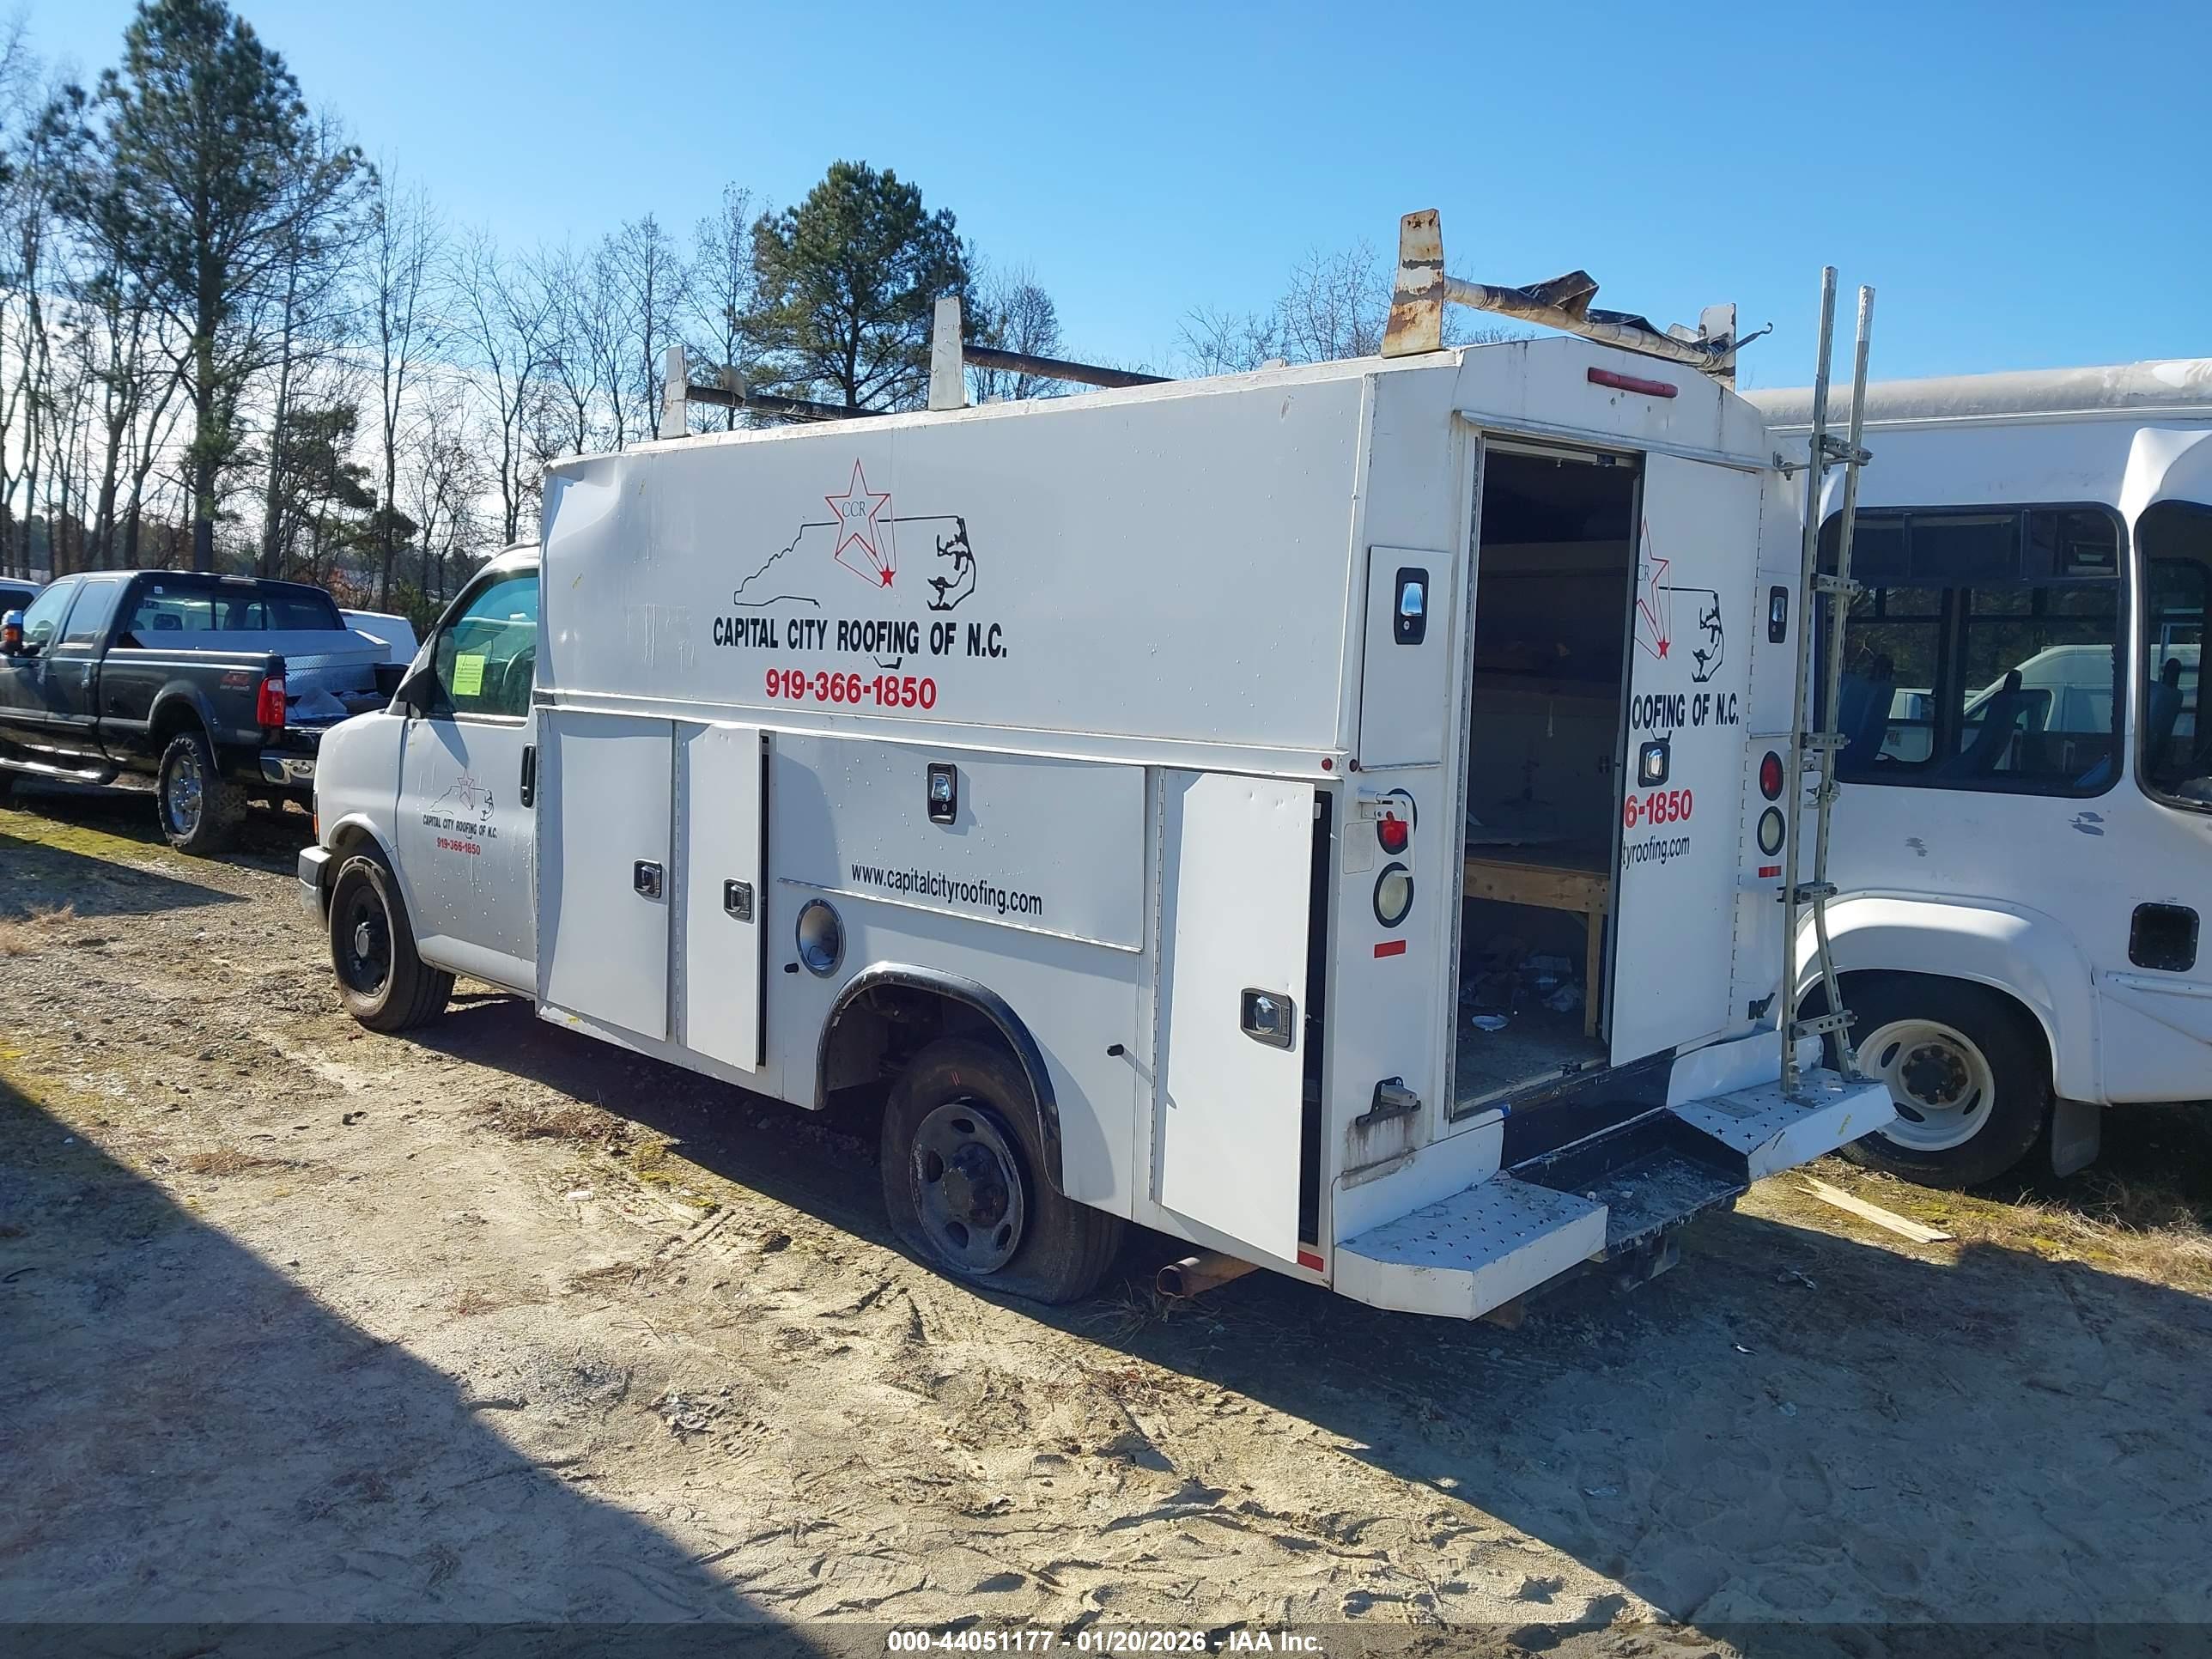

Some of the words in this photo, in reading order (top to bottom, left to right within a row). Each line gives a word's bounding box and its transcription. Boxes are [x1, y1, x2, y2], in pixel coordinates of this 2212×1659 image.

[842, 501, 866, 518] CCR
[712, 617, 779, 650] CAPITAL
[787, 619, 828, 652] CITY
[837, 620, 919, 654] ROOFING
[930, 623, 957, 656] OF
[967, 623, 1008, 659] N.C.
[765, 668, 937, 710] 919-366-1850
[1632, 693, 1686, 730] OOFING
[1692, 693, 1711, 726] OF
[1716, 692, 1740, 726] N.C.
[422, 814, 441, 828] CAPITAL
[442, 818, 454, 830] CITY
[455, 821, 477, 835] ROOFING
[478, 824, 487, 836] OF
[488, 826, 497, 838] N.C.
[1625, 788, 1693, 829] 6-1850
[436, 836, 481, 855] 919-366-1850
[851, 864, 1042, 915] www.capitalcityroofing.com
